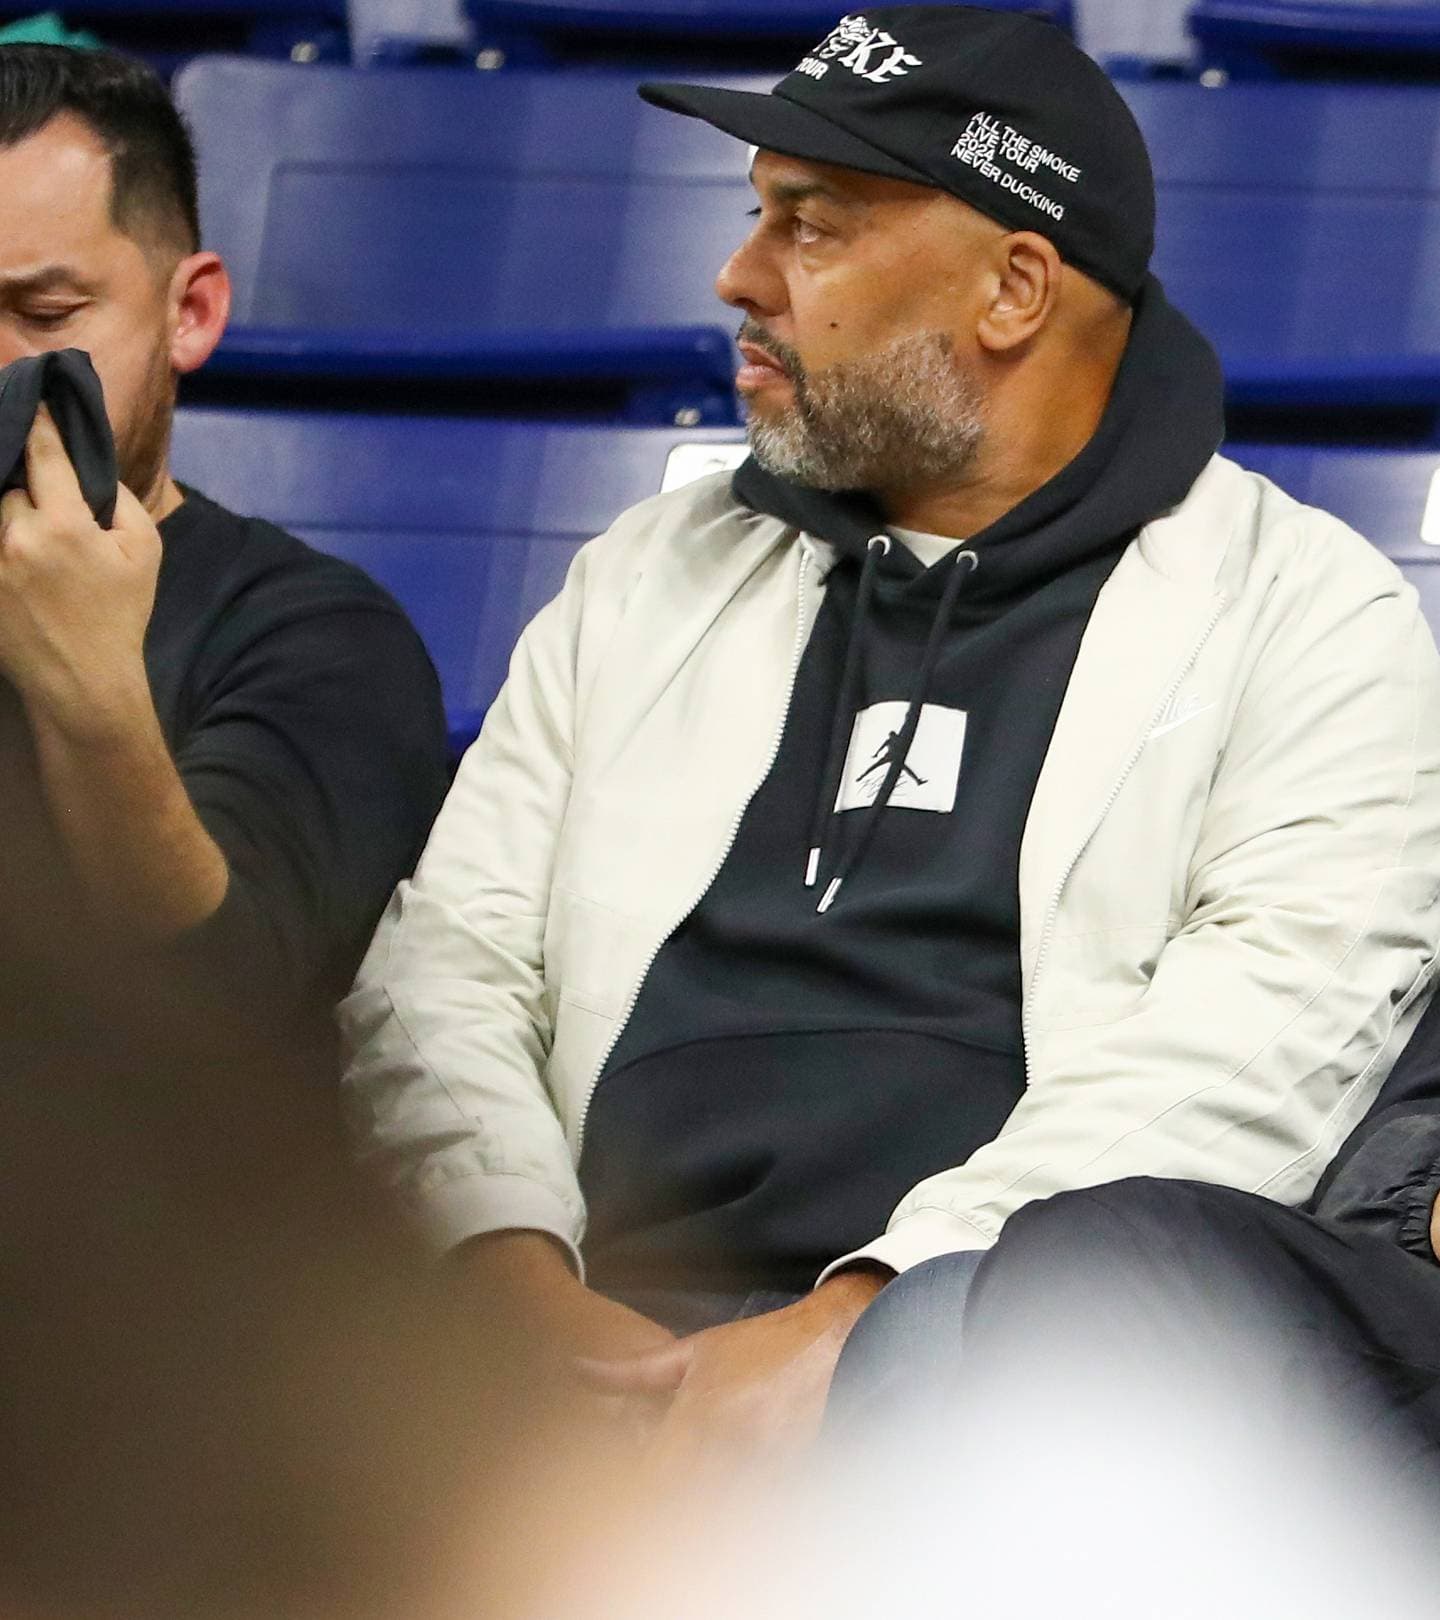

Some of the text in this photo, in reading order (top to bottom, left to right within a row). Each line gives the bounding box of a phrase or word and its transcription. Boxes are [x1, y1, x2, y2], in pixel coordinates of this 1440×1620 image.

[958, 132, 995, 162] 2024
[965, 121, 1039, 173] LIVE TOUR
[971, 112, 1081, 182] ALL THE SMOKE
[950, 143, 1064, 219] NEVER DUCKING
